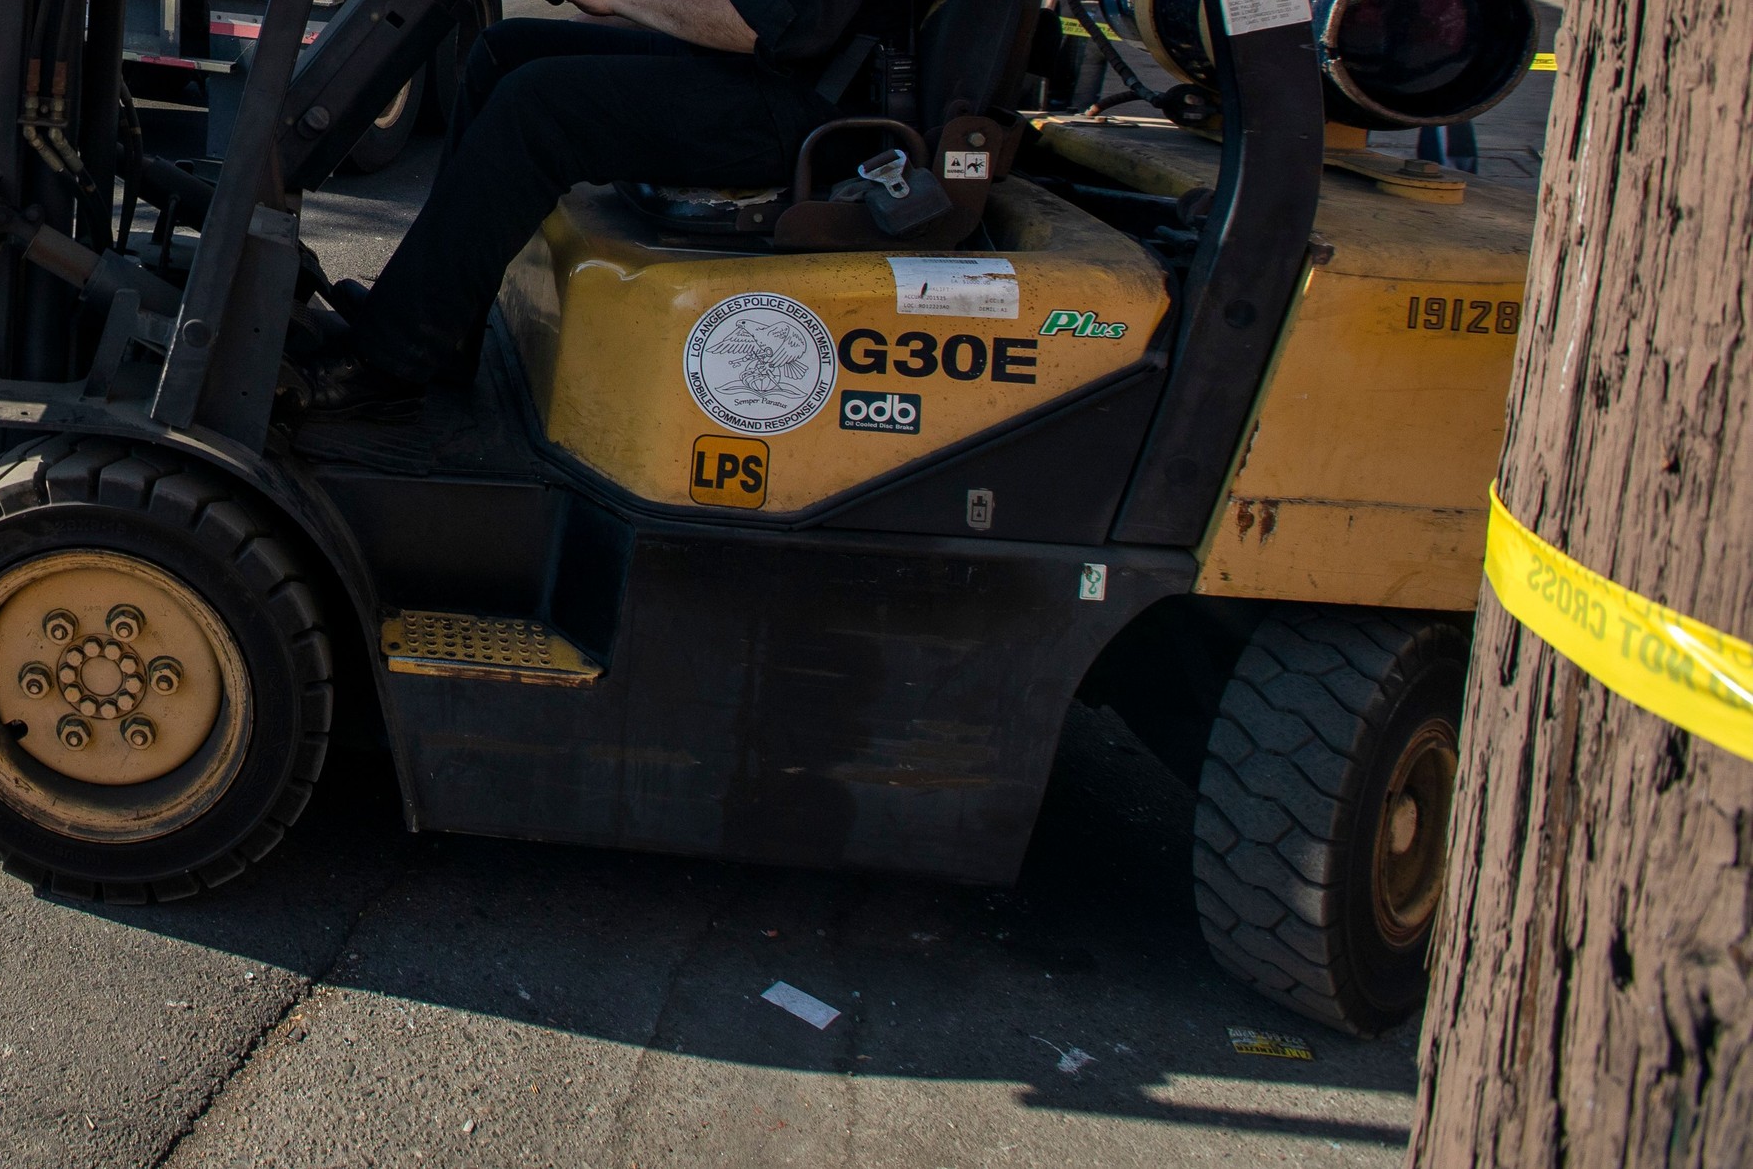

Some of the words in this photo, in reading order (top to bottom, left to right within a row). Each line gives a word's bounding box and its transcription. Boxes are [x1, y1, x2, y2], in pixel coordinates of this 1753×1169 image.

[691, 336, 703, 358] LOS
[699, 300, 742, 336] ANGELES
[744, 297, 785, 310] POLICE
[786, 303, 832, 366] DEPARTMENT
[1038, 310, 1128, 339] Plus
[1407, 296, 1521, 335] 19128
[838, 328, 1038, 384] G30E
[690, 371, 714, 408] MOBILE
[711, 405, 762, 430] COMMAND
[764, 400, 816, 430] RESPONSE
[813, 380, 829, 405] UNIT
[734, 397, 760, 407] Semper
[761, 397, 787, 409] Paratus
[845, 394, 916, 424] odb
[845, 420, 854, 428] Oil
[855, 421, 877, 429] Cooled
[694, 450, 763, 494] LPS
